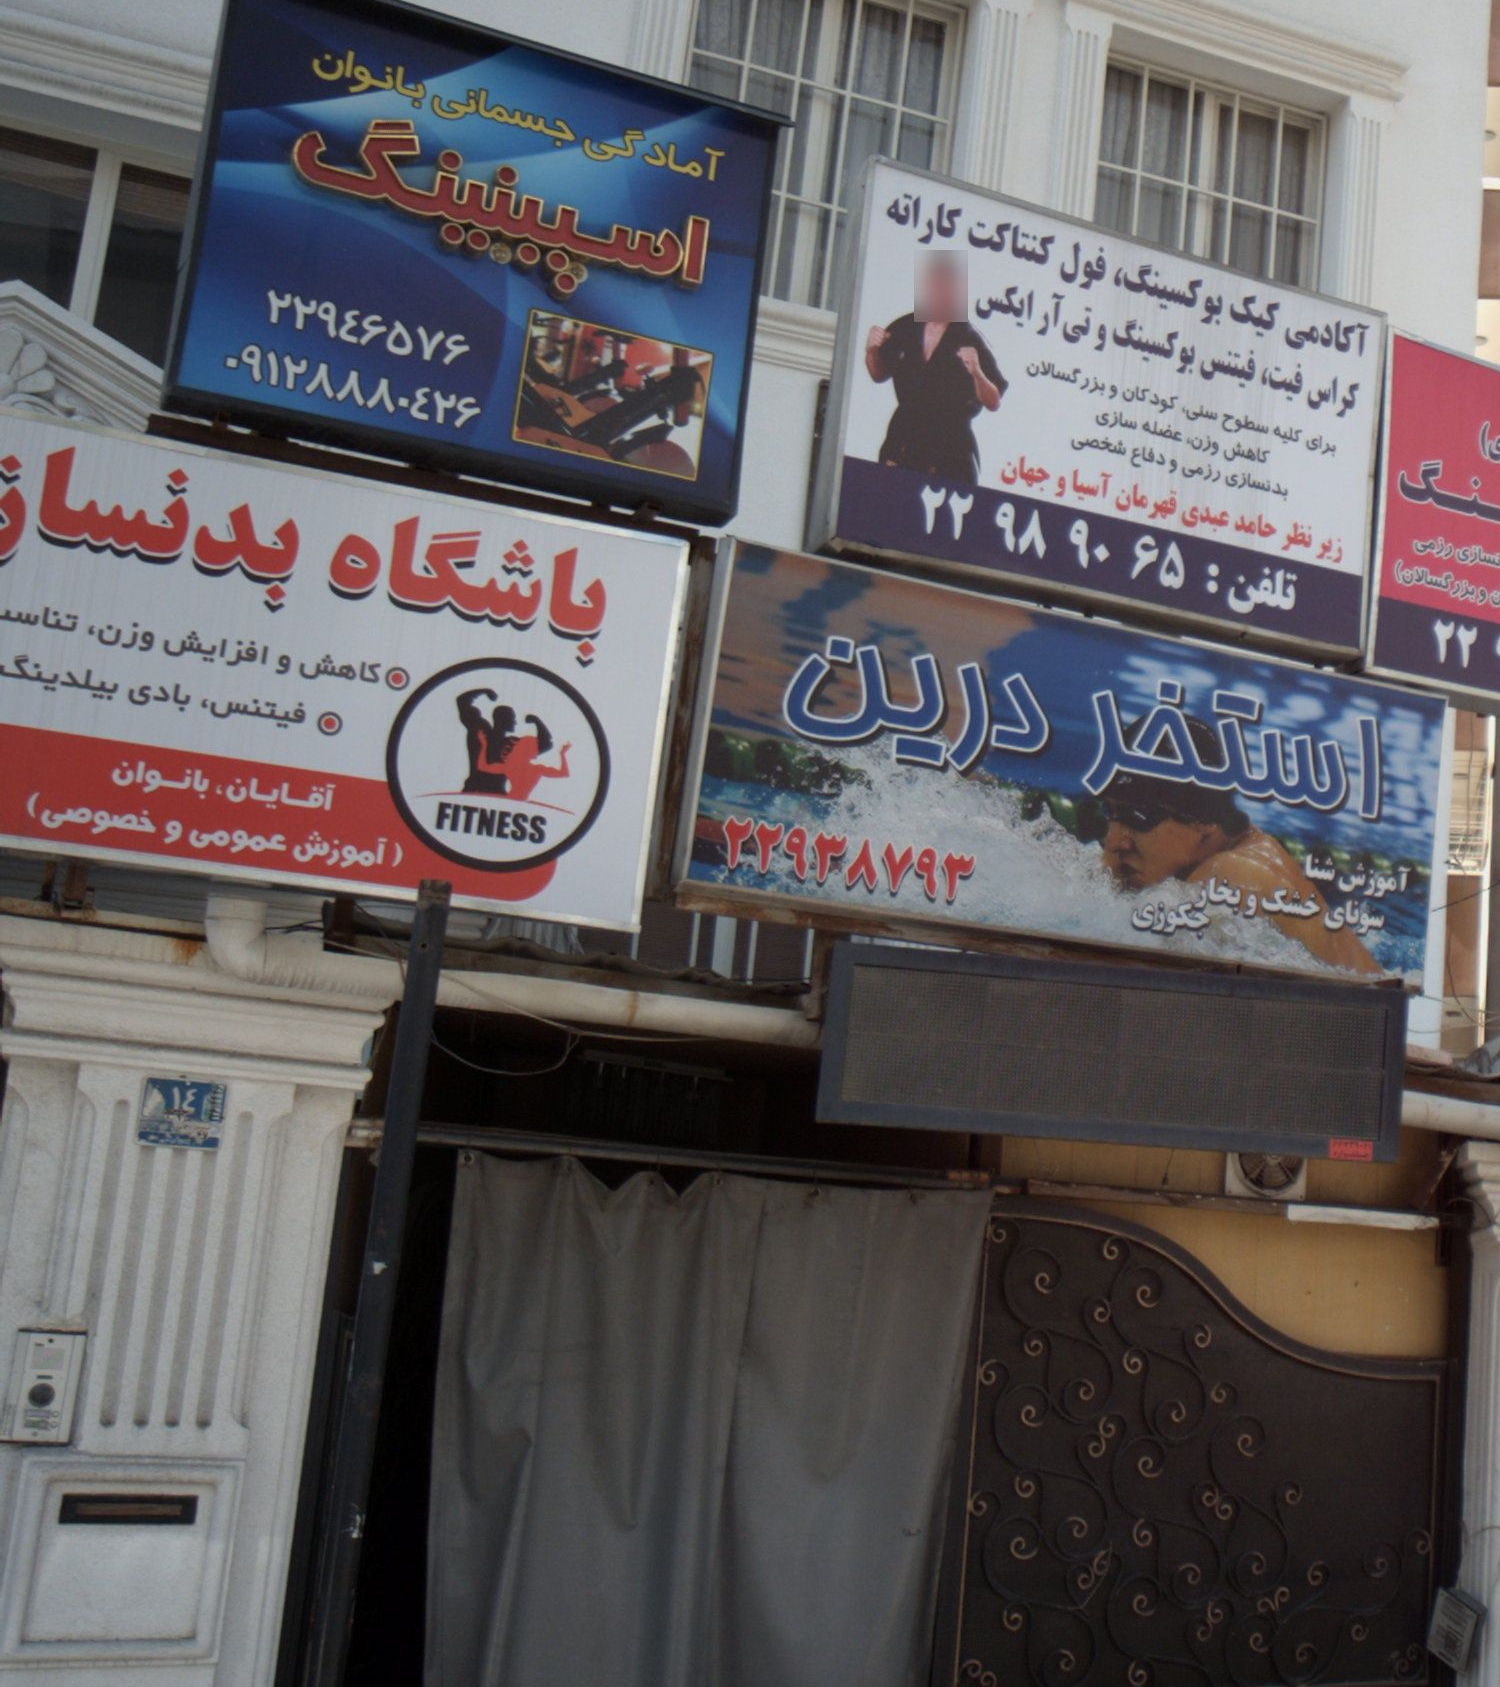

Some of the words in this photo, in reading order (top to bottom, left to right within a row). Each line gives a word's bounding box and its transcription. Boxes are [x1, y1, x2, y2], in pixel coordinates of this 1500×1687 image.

[312, 50, 427, 109] بانوان
[432, 89, 576, 147] جسمانی
[582, 130, 725, 182] آمادگی
[292, 119, 711, 297] اسپینینگ
[886, 193, 963, 244] کاراته
[968, 221, 1056, 265] کنتاکت
[1060, 241, 1107, 290] فول
[975, 285, 1034, 328] ایکس
[1230, 295, 1280, 338] کیک
[1096, 323, 1108, 352] و
[1112, 319, 1196, 374] بوکسینگ
[1285, 321, 1370, 357] آکادمی
[1026, 361, 1106, 397] بزرگسالان
[1200, 349, 1256, 389] فیتنس
[1109, 384, 1119, 399] و
[1122, 385, 1178, 414] کودکان
[1307, 376, 1360, 418] کراس
[1095, 410, 1138, 431] سازی
[1142, 419, 1183, 443] عضله
[1222, 410, 1270, 435] سطوح
[1273, 423, 1303, 444] کلیه
[1070, 435, 1127, 457] شخصی
[1130, 446, 1166, 468] دفاع
[1224, 442, 1271, 464] کاهش
[1306, 435, 1337, 457] برای
[1000, 456, 1050, 494] جهان
[1170, 459, 1179, 474] و
[1182, 460, 1221, 482] رزمی
[1054, 474, 1066, 498] و
[1072, 469, 1112, 502] آسیا
[1115, 483, 1178, 520] قهرمان
[1225, 469, 1289, 501] بدنسازی
[1181, 505, 1230, 533] عبدی
[1234, 514, 1277, 539] حامد
[920, 484, 974, 541] ۲۲
[995, 501, 1047, 560] ۹۸
[1068, 519, 1112, 569] ۹۰
[1131, 535, 1186, 590] ۶۵
[1281, 522, 1313, 552] نظر
[1316, 538, 1344, 563] زیر
[1414, 537, 1454, 558] رزمی
[329, 515, 607, 667] باشگاه
[1478, 587, 1488, 604] و
[164, 631, 269, 667] افزایش
[1433, 618, 1478, 669] ۲۲
[0, 654, 119, 701] بیلدینگ
[276, 650, 292, 674] و
[300, 654, 381, 685] کاهش
[128, 682, 191, 708] بادی
[782, 635, 1051, 772] درین
[1082, 679, 1381, 821] استخر
[111, 760, 210, 799] بانوان
[164, 819, 182, 844] و
[435, 801, 548, 845] FITNESS
[188, 828, 286, 854] عمومی
[723, 815, 977, 903] ۲۲۹۳۸۷۹۳
[1305, 853, 1335, 881] شنا
[1198, 876, 1242, 913] بخار
[1338, 863, 1412, 898] آموزش
[1246, 895, 1258, 916] و
[1261, 887, 1321, 917] خشک
[1324, 901, 1385, 935] سونای
[1132, 901, 1211, 938] جکوزی
